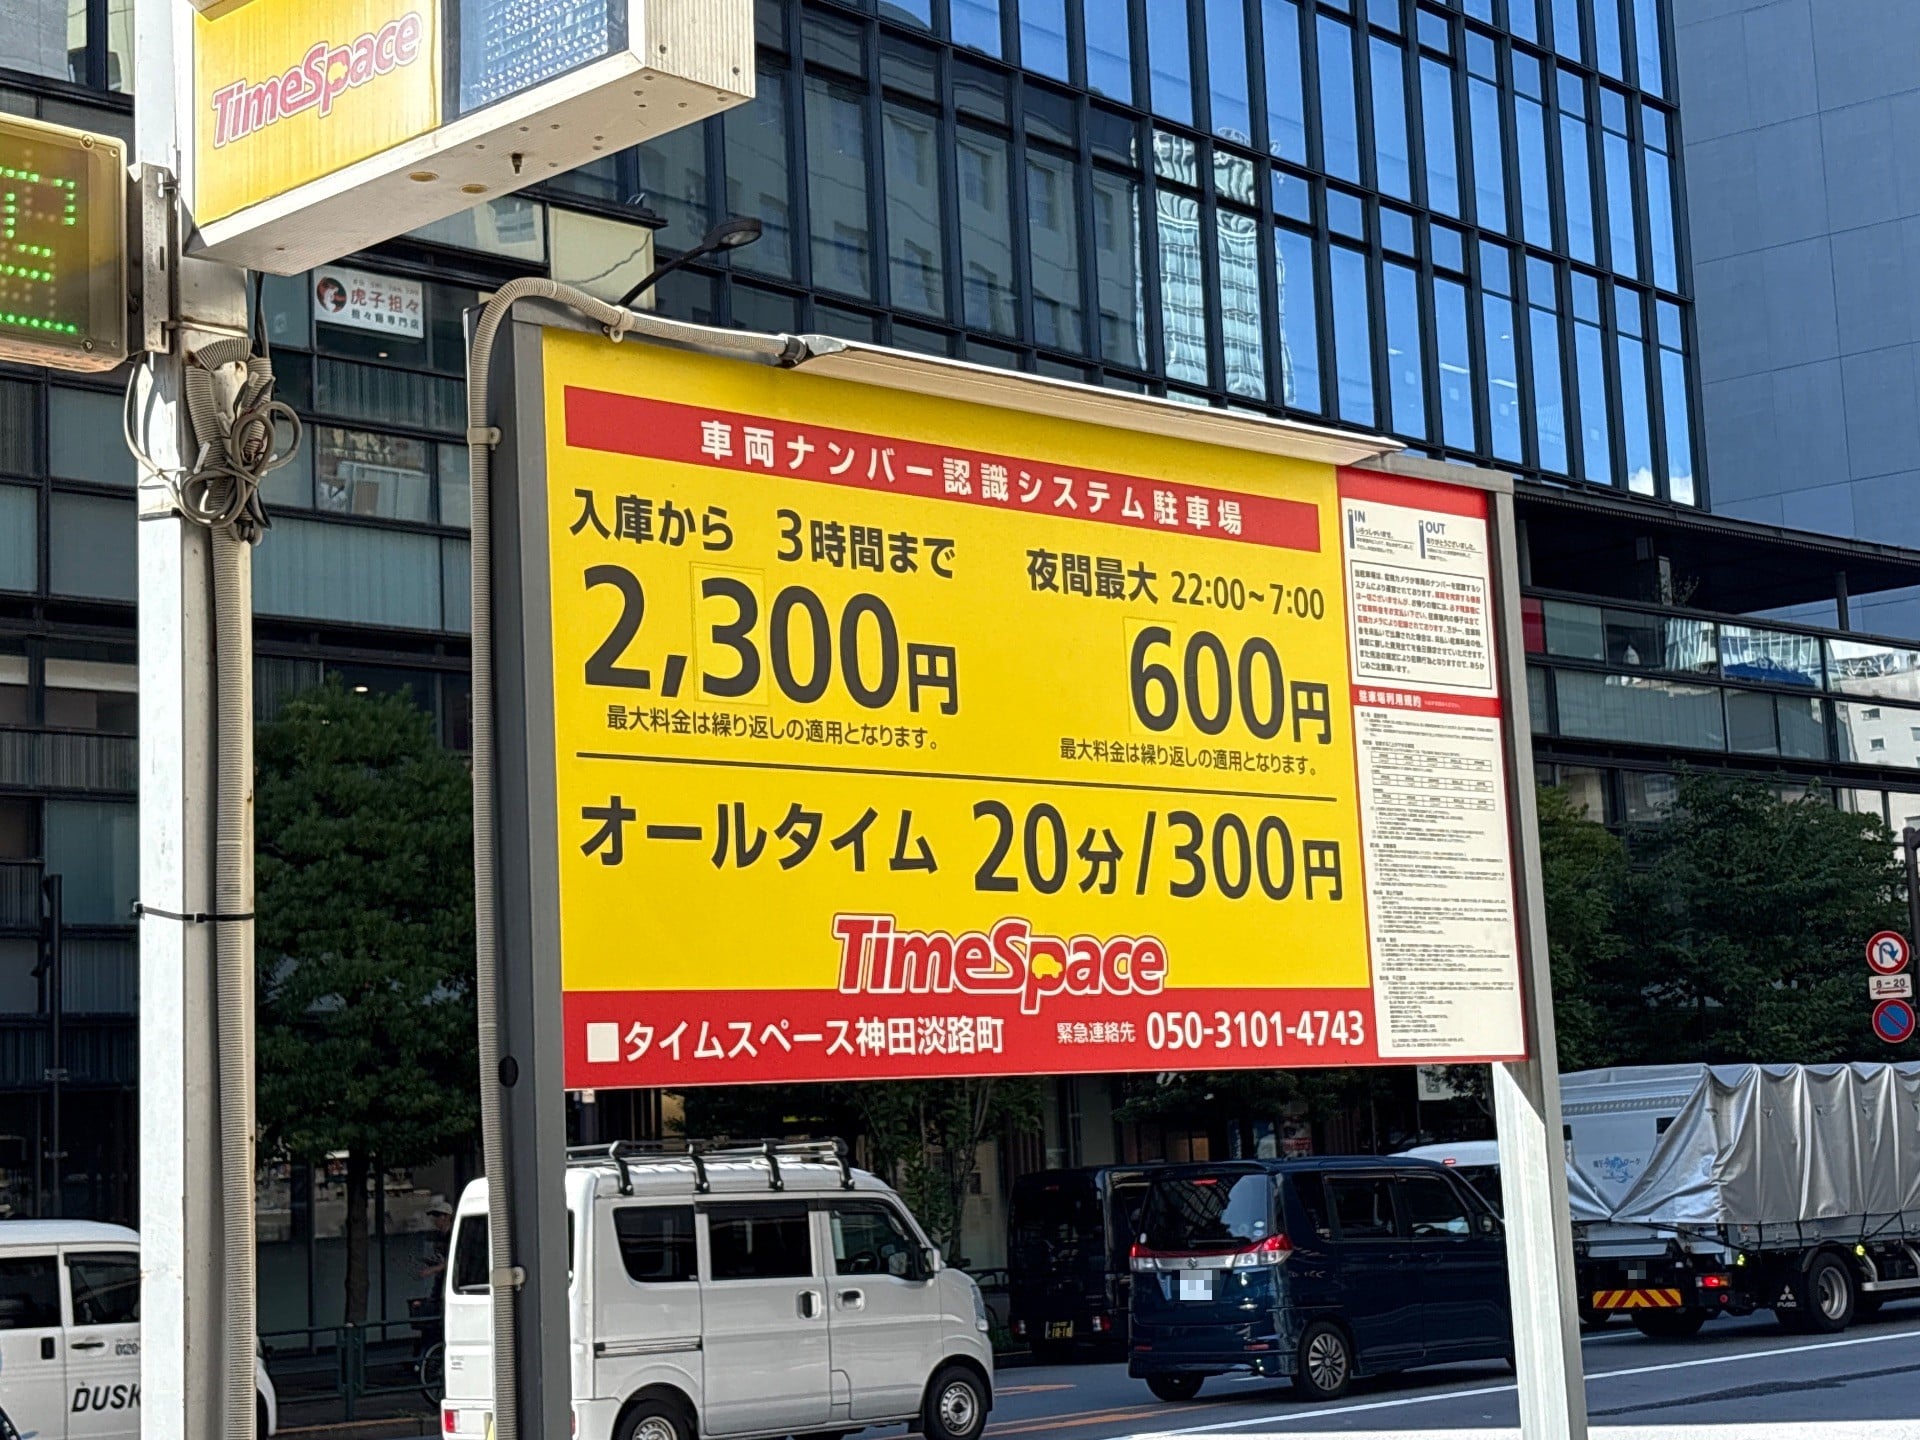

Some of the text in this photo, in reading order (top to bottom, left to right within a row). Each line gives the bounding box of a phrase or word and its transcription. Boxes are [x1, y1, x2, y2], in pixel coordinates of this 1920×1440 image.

[212, 12, 422, 149] TimeSpace
[700, 420, 1243, 536] 車両ナンバー認識システム駐車場
[1354, 510, 1366, 523] IN
[569, 488, 955, 578] 入庫から 3時間まで
[1425, 521, 1446, 535] OUT
[1026, 548, 1158, 604] 夜間最大
[583, 564, 958, 715] 2,300円
[1130, 626, 1332, 744] 600円
[606, 704, 938, 751] 最大料金は繰り返しの適用となります。
[1060, 737, 1316, 776] 最大料金は繰り返しの適用となります。
[580, 795, 938, 874] オールタイム
[833, 912, 1168, 1014] TimeSpace
[1057, 1010, 1365, 1050] 緊急連絡先 050-3101-4743
